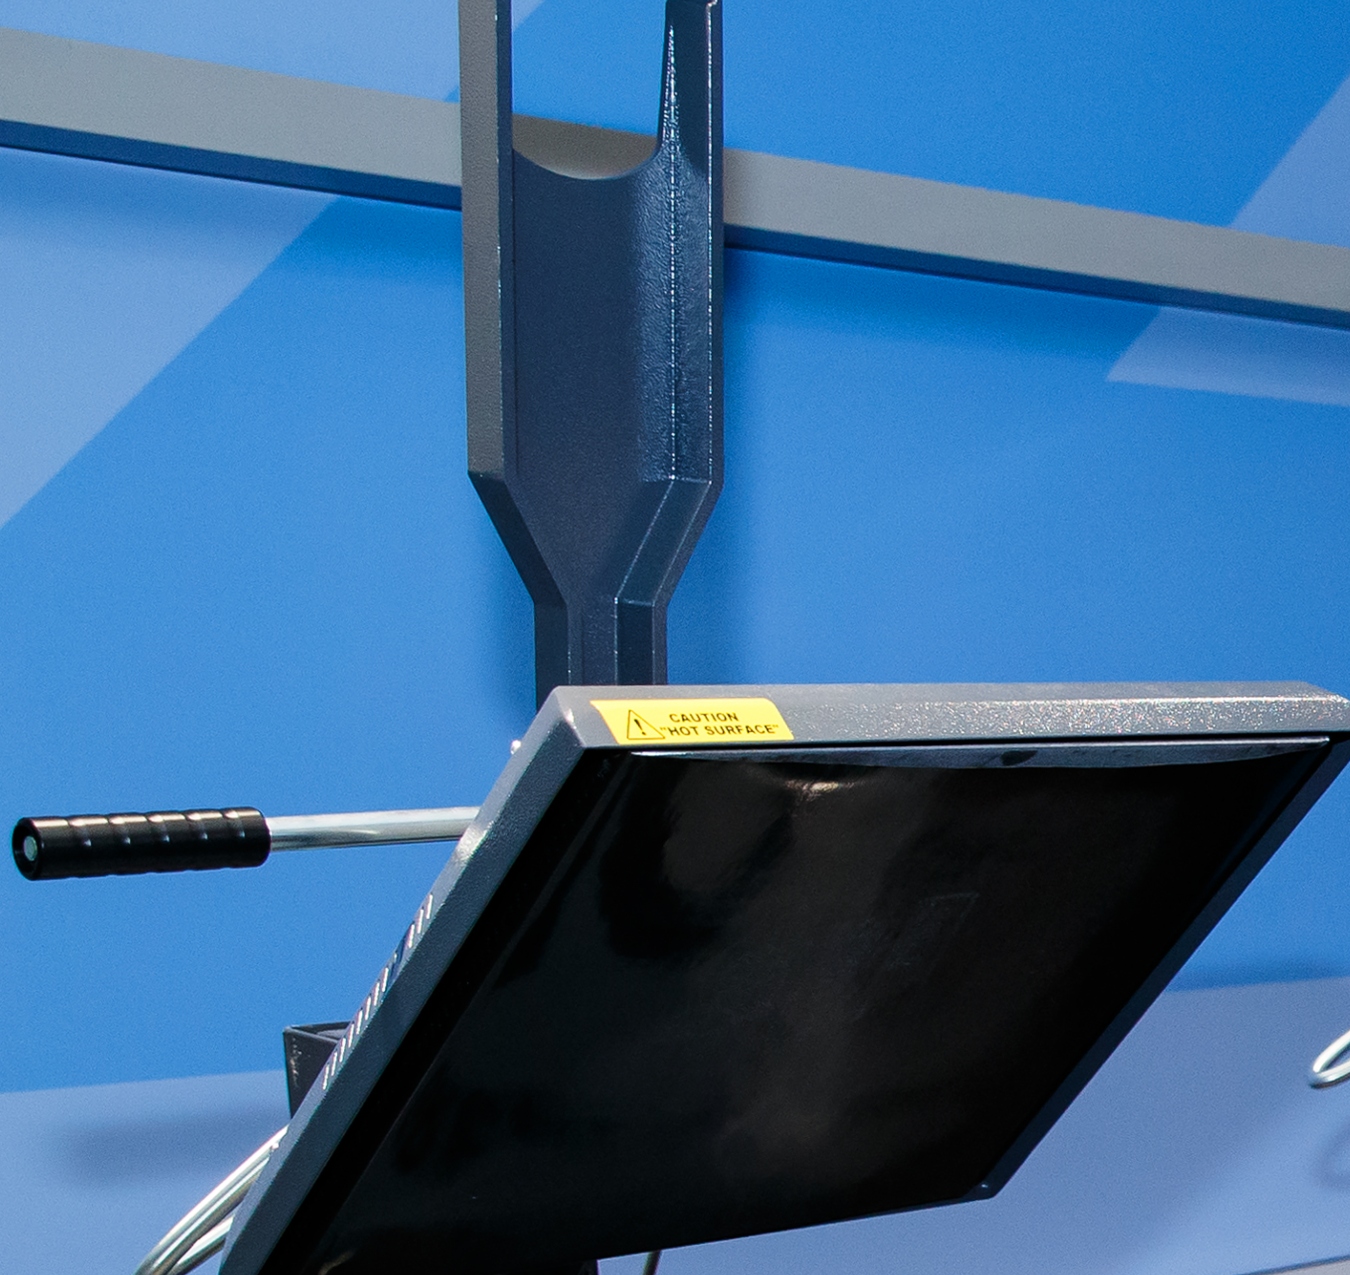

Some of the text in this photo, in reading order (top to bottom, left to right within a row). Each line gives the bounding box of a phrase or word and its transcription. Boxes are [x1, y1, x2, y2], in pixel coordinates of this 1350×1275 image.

[669, 712, 739, 723] CAUTION
[660, 724, 778, 736] "HOT SURFACE"
